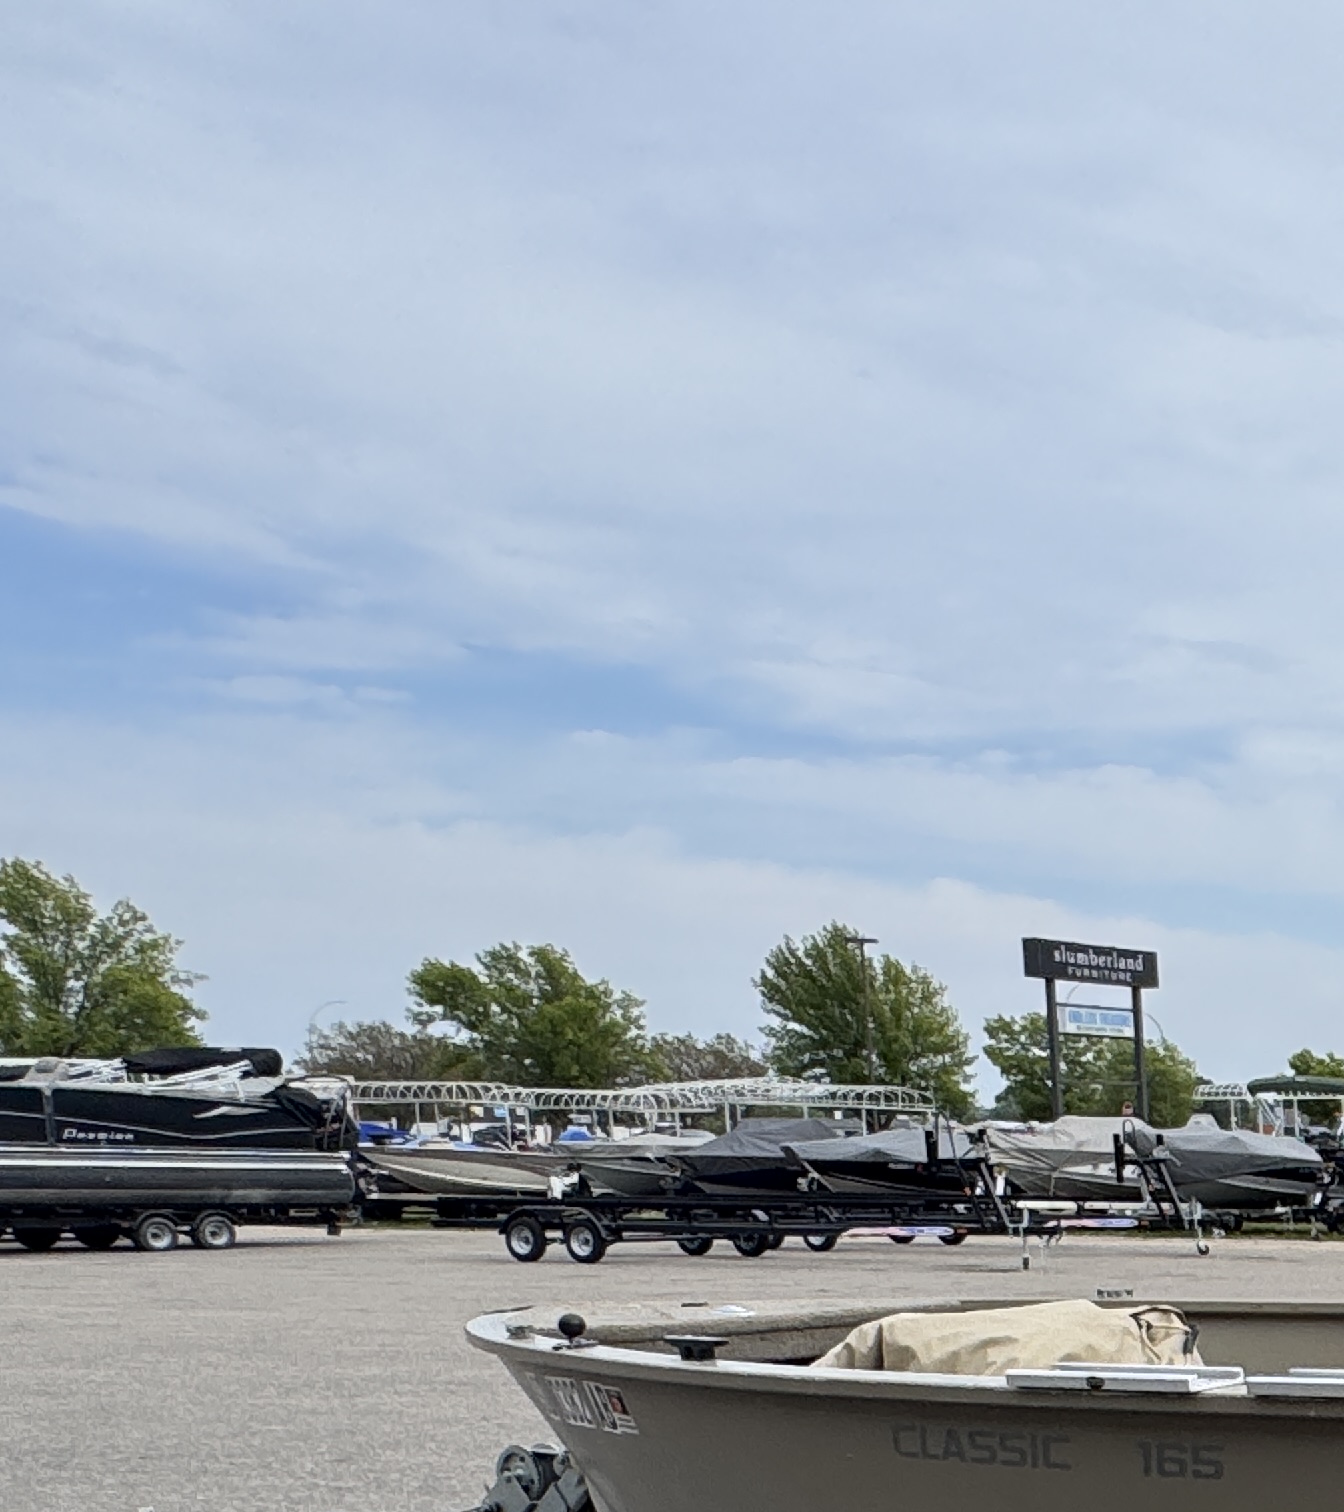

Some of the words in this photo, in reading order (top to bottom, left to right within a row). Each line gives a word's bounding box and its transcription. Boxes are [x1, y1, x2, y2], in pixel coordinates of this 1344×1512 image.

[1053, 945, 1144, 972] slumberland
[892, 1424, 1073, 1471] CLASSIC
[1137, 1439, 1227, 1480] 165
